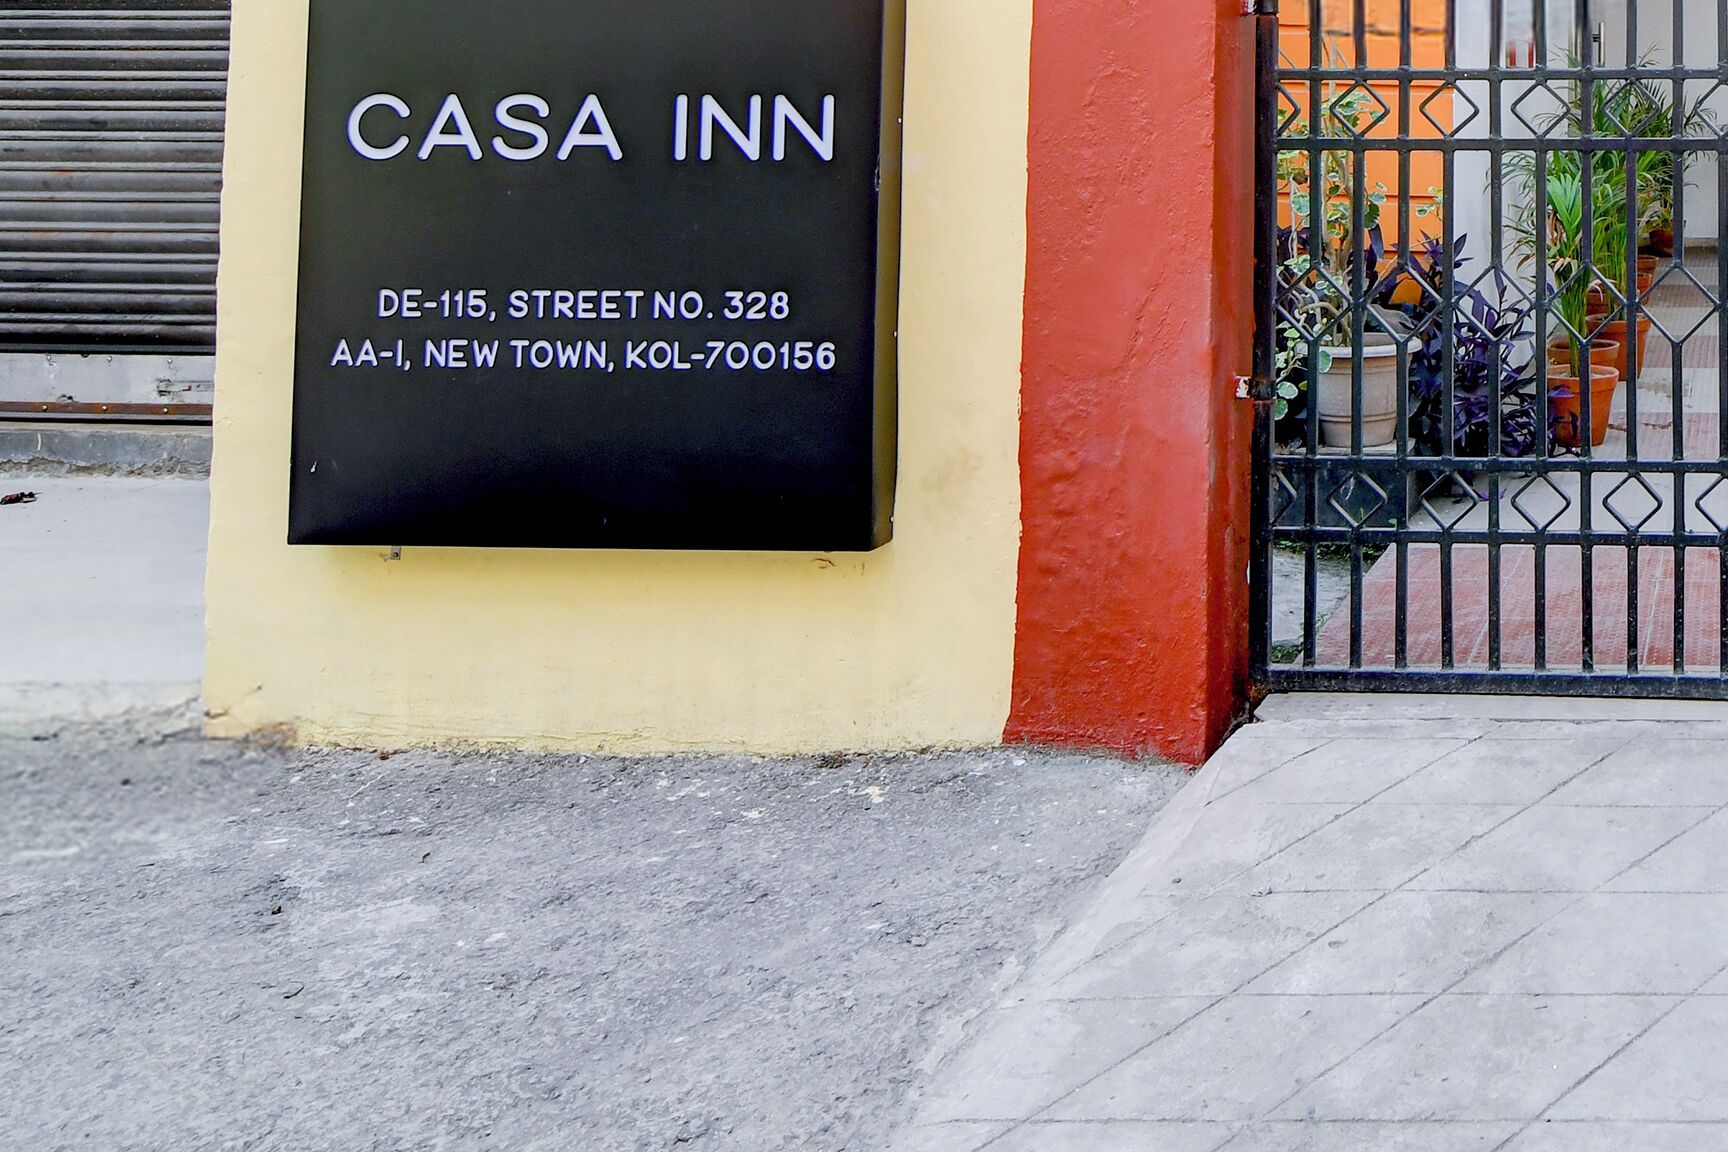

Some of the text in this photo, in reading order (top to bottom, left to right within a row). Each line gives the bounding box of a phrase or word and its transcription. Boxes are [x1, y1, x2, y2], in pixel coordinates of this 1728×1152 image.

[346, 92, 836, 162] CASA INN
[377, 288, 791, 322] DE-115, STREET NO. 328
[423, 338, 500, 369] NEW
[508, 339, 616, 373] TOWN,
[624, 340, 837, 371] KOL-700156
